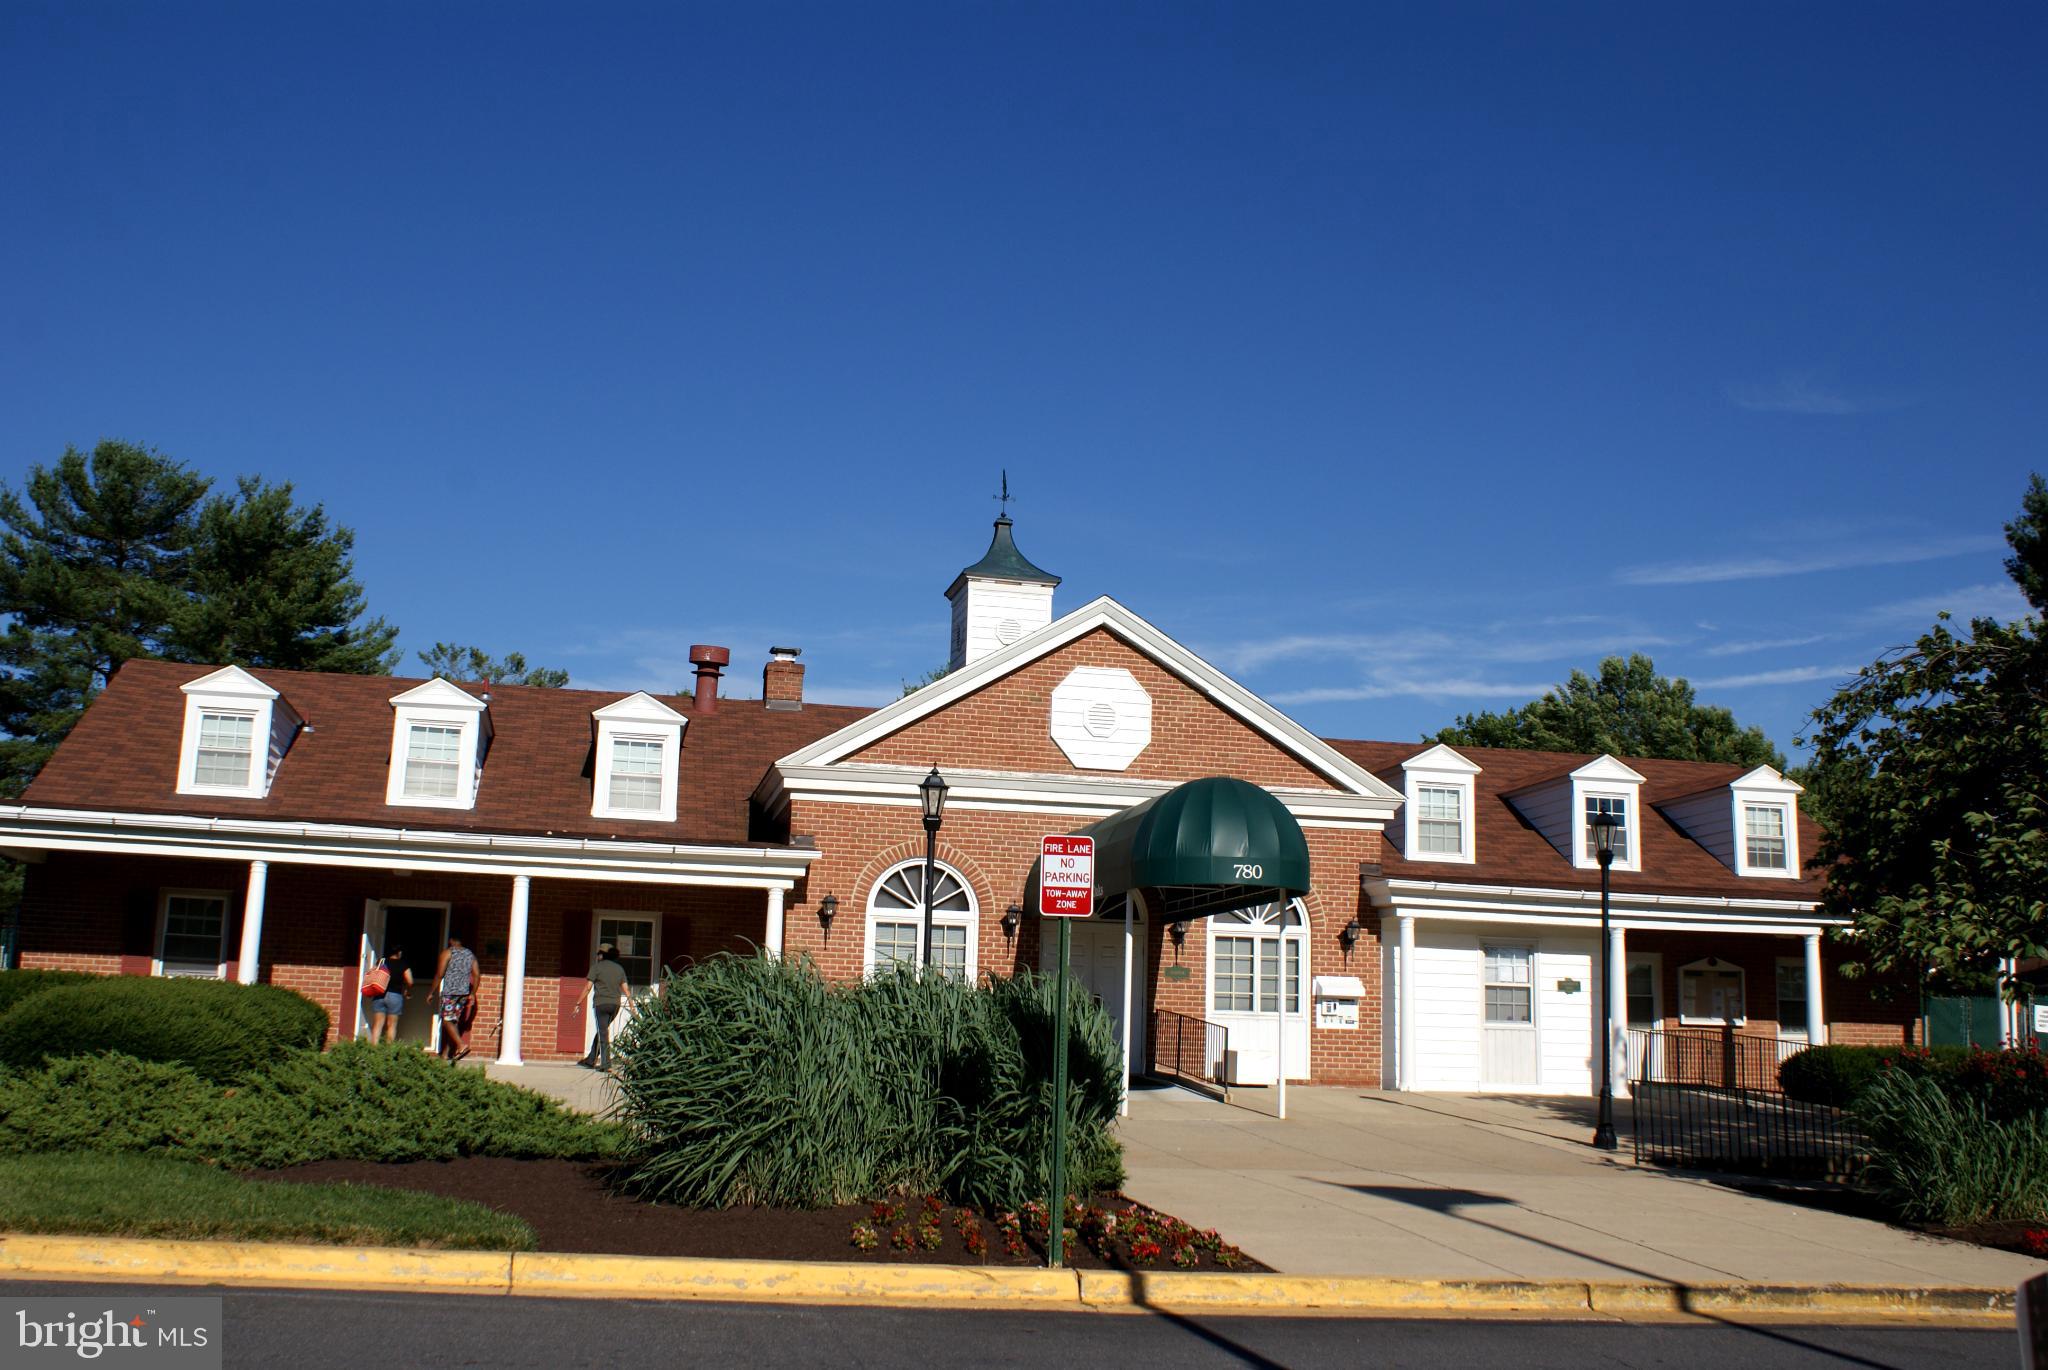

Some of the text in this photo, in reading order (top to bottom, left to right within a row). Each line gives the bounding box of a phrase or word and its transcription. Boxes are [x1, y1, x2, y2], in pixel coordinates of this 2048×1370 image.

[1044, 843, 1092, 854] FIRE LANE
[1060, 858, 1075, 869] NO
[1233, 864, 1263, 879] 780
[1045, 872, 1090, 883] PARKING
[1046, 889, 1088, 899] TOW-AWAY
[1056, 900, 1077, 909] ZONE
